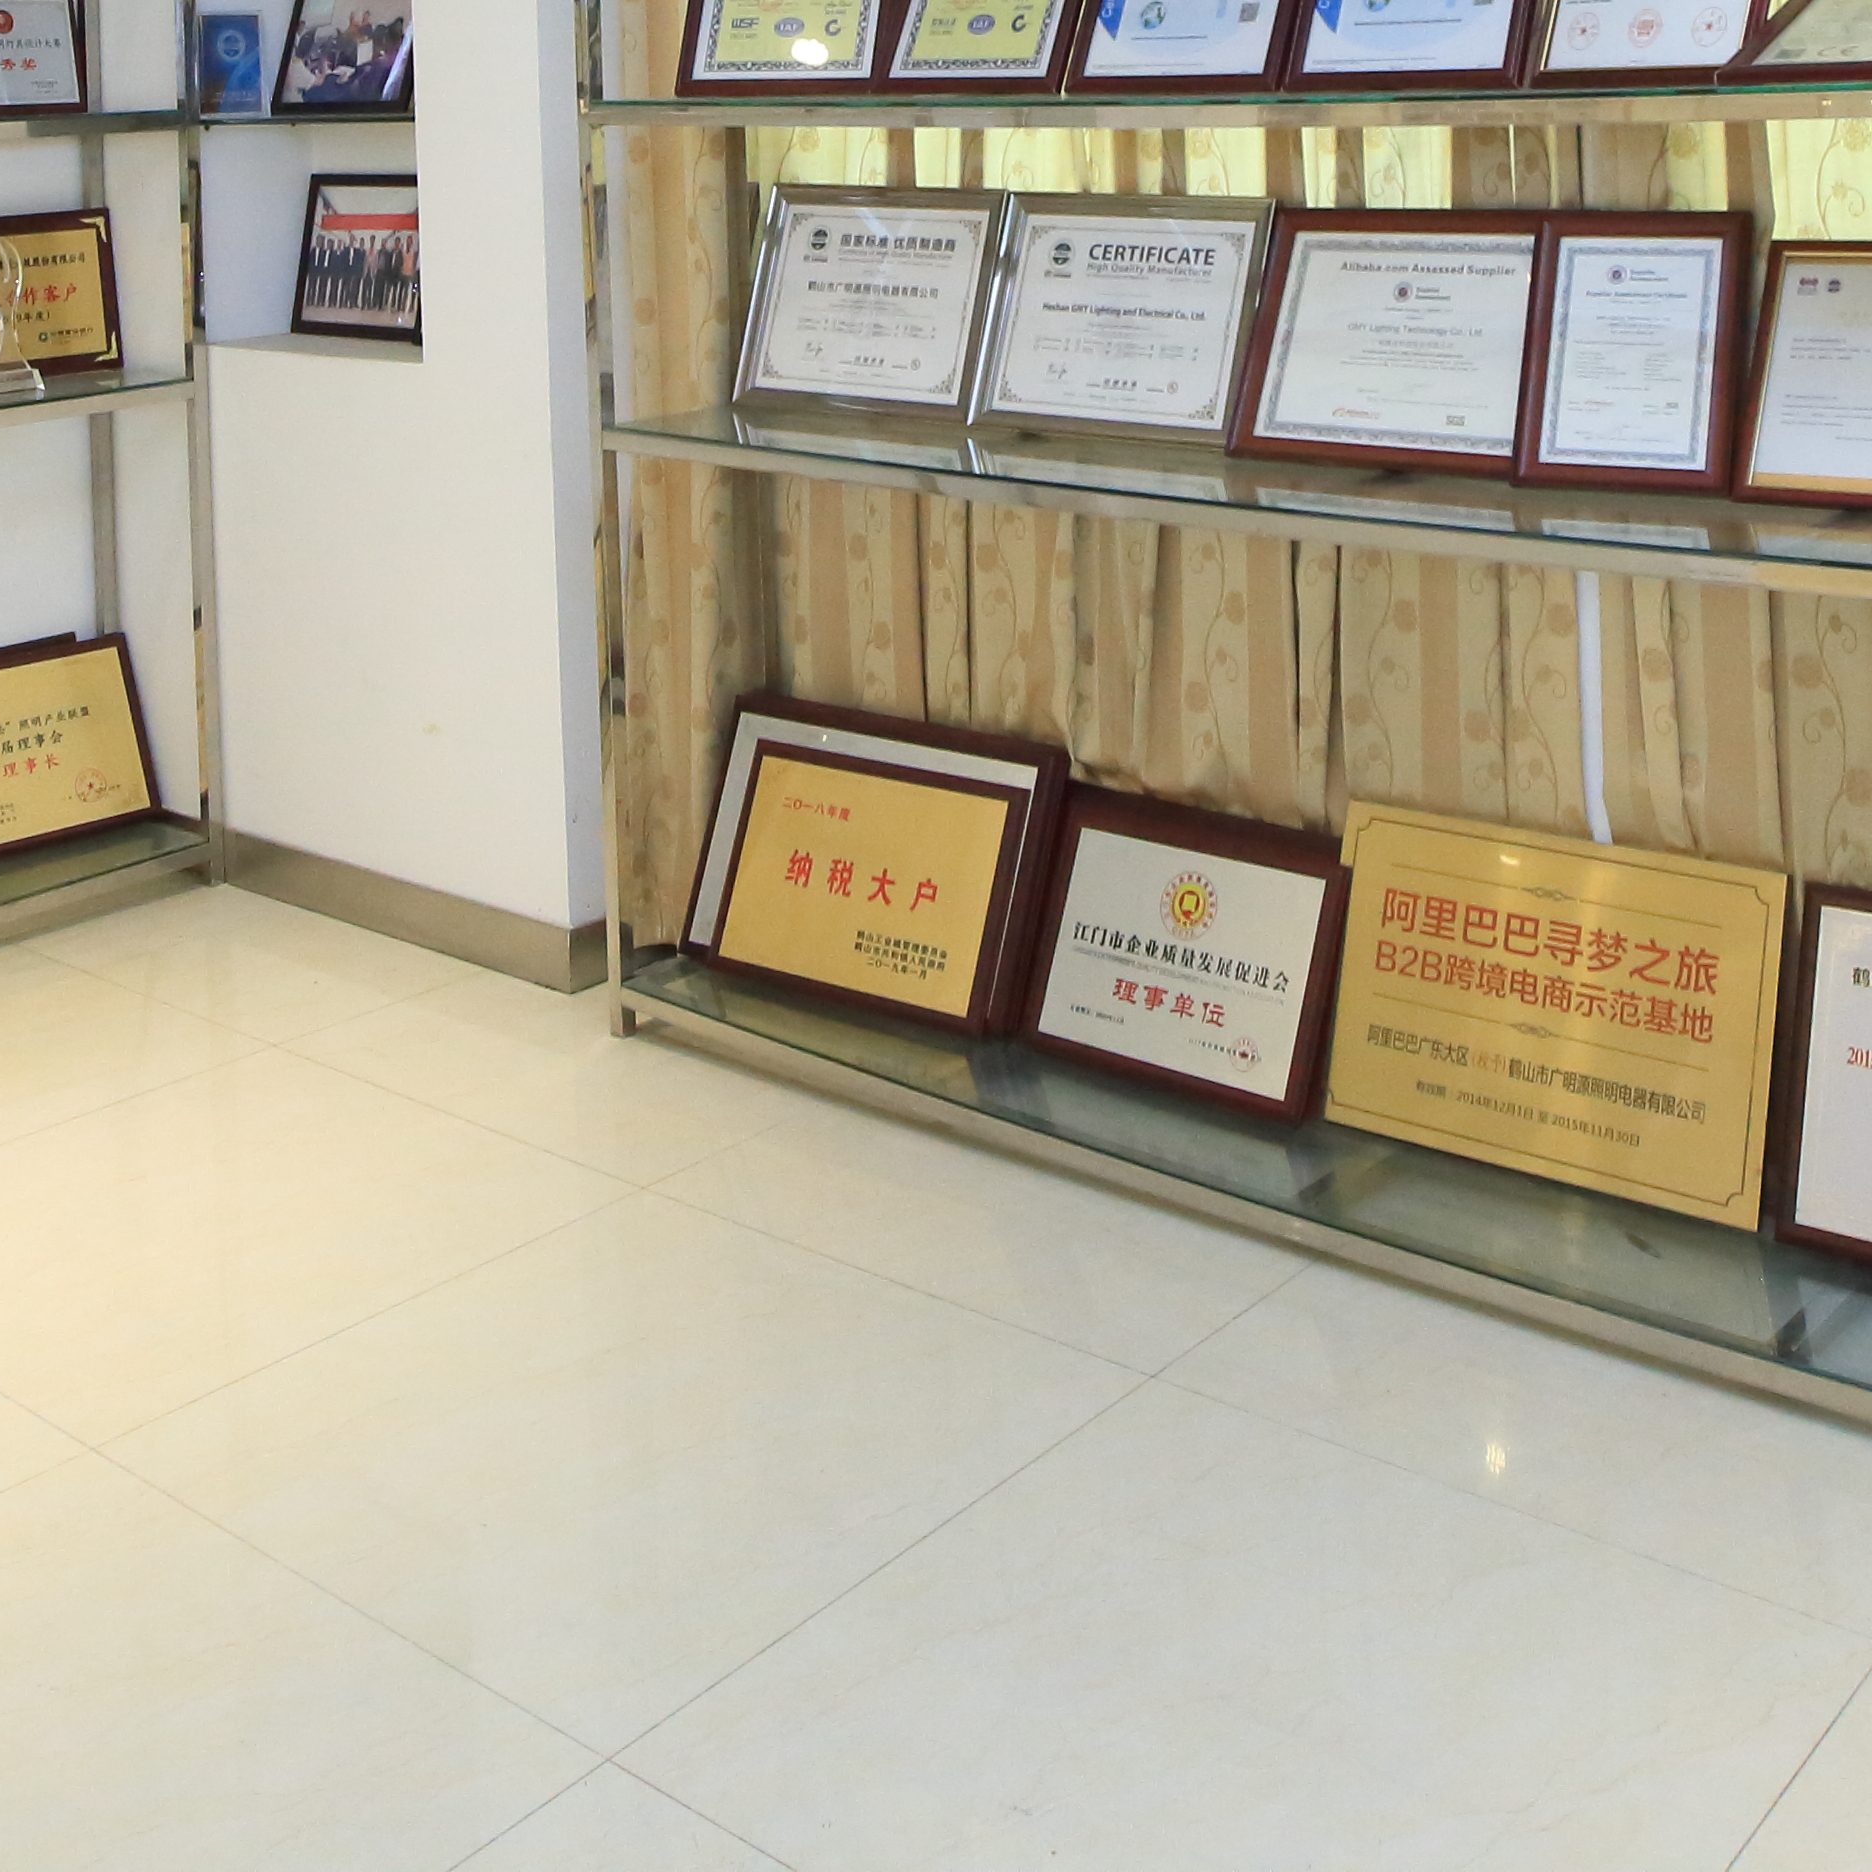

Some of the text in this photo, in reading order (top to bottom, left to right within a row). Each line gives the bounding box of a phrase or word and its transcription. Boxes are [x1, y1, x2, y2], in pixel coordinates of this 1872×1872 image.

[840, 233, 888, 247] 国家标准
[1089, 244, 1216, 265] CERTIFICATE
[1087, 263, 1108, 271] High
[1111, 265, 1144, 275] Quality
[1411, 264, 1464, 274] Assessed
[1467, 265, 1516, 277] Supplier
[784, 848, 939, 911] 纳税大户
[1073, 921, 1290, 994] 江门市企业质量发展促进会
[1381, 887, 1720, 995] 阿里巴巴寻梦之旅
[1112, 977, 1226, 1028] 理事单位
[1374, 940, 1715, 1045] B2B跨境电商示范基地
